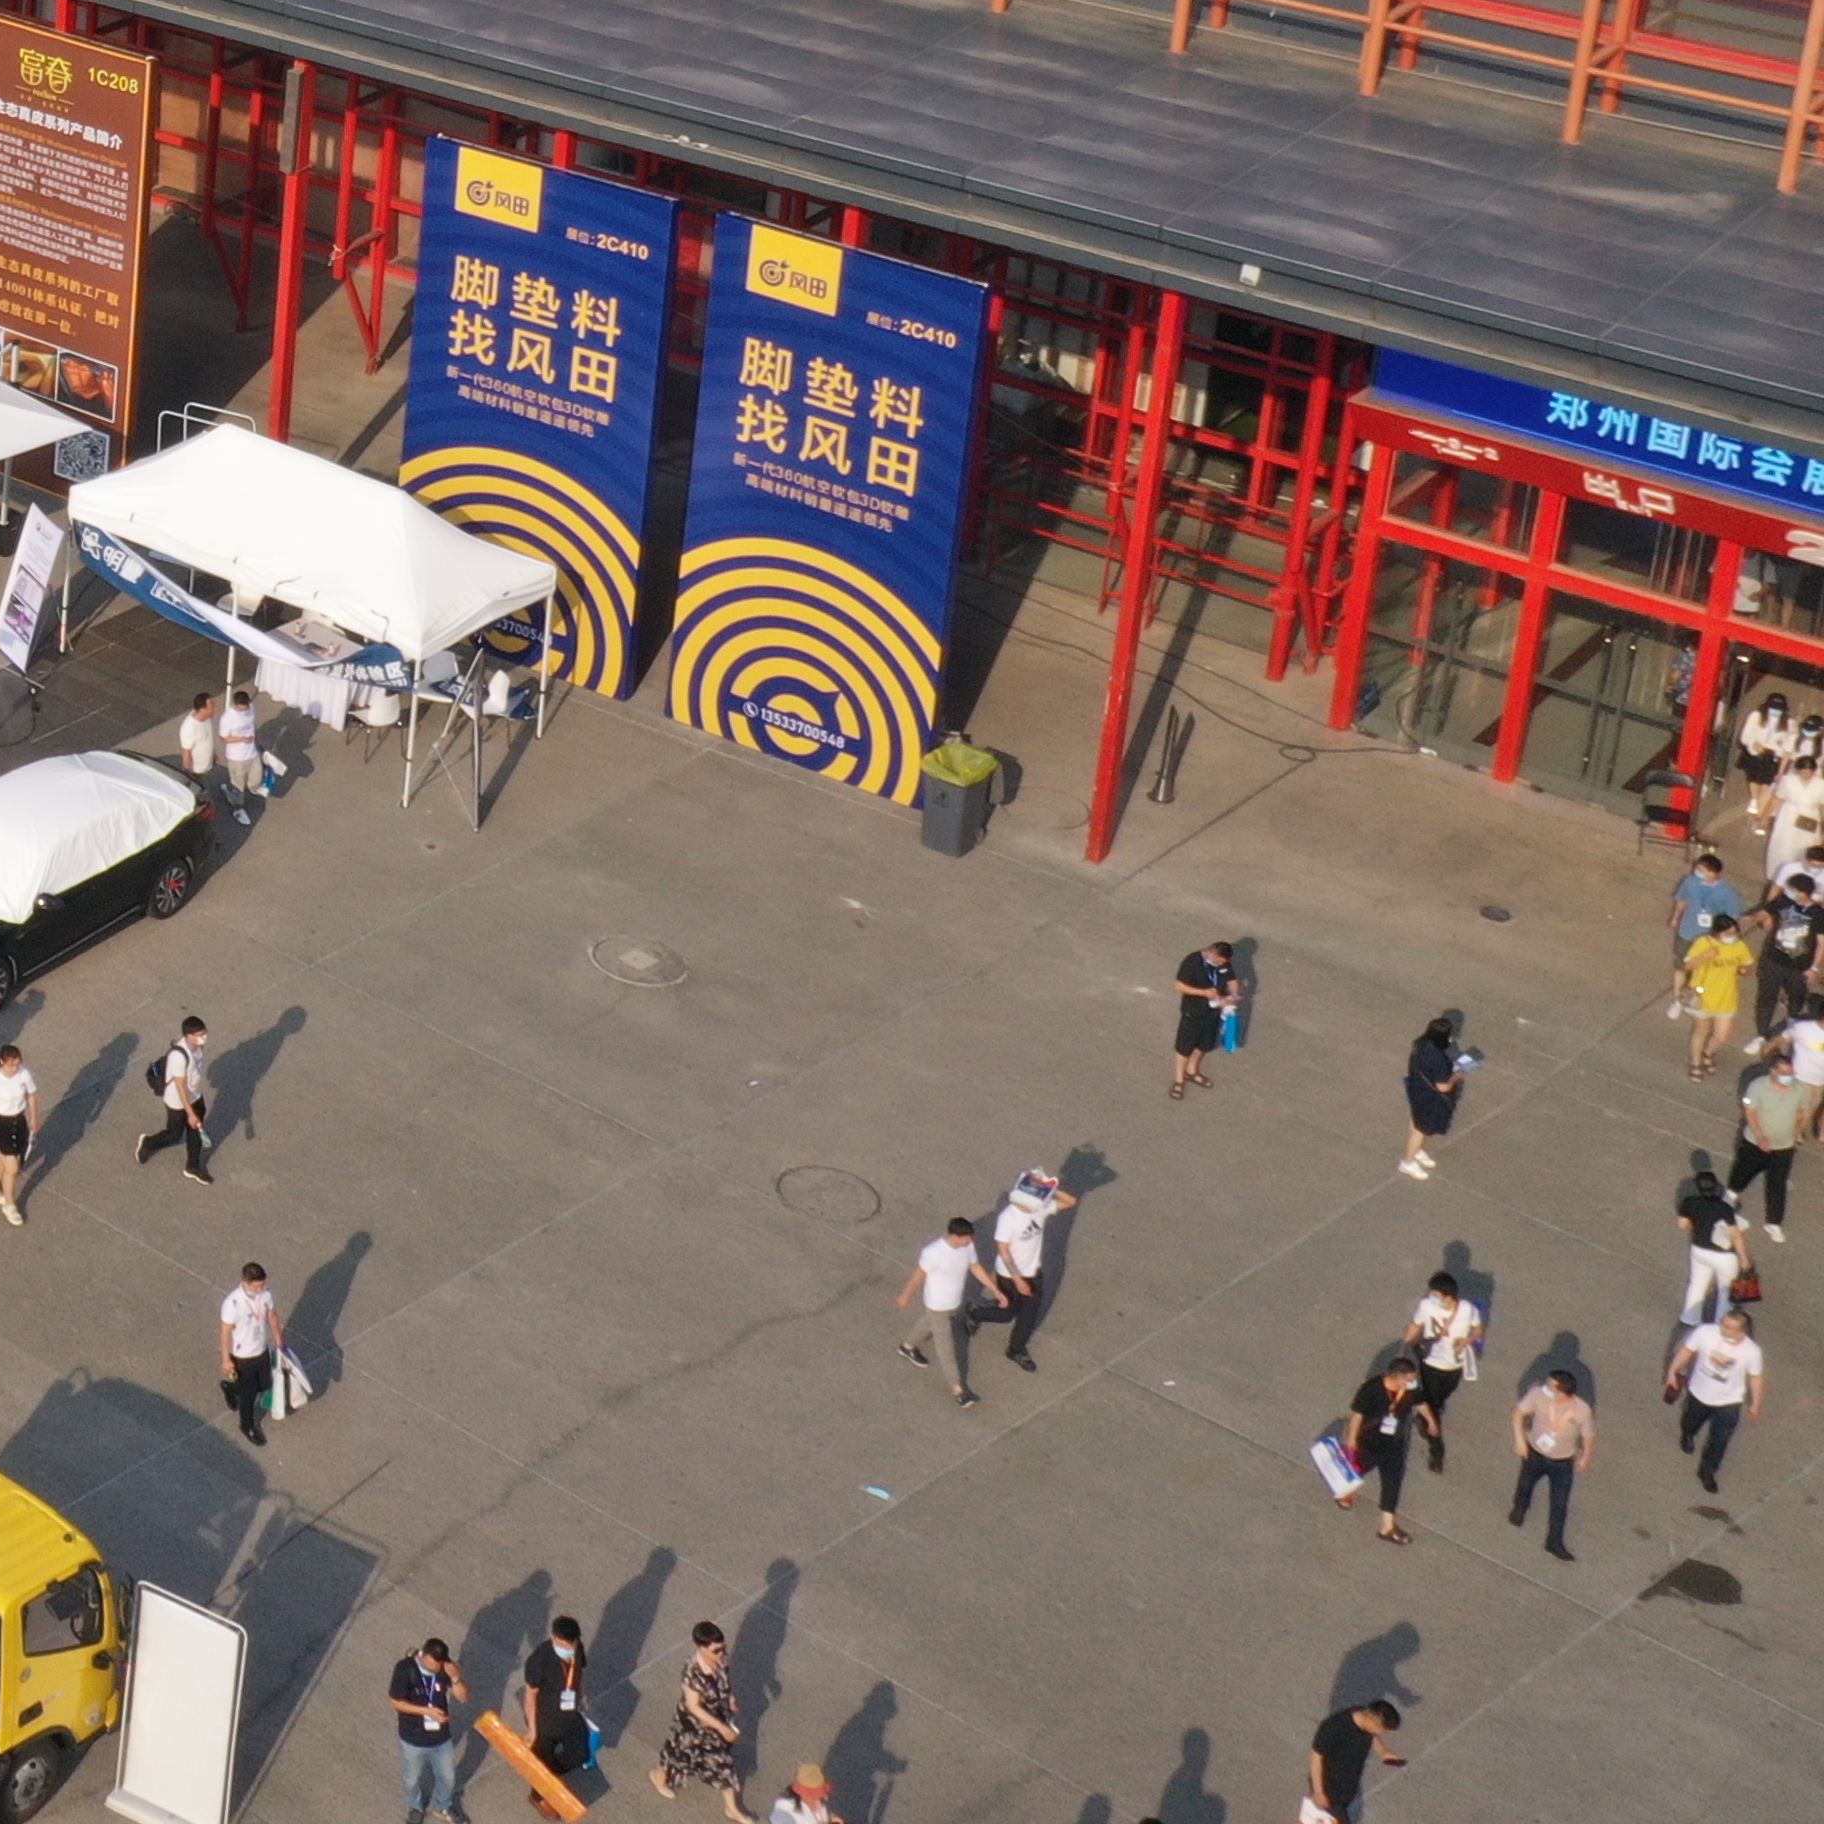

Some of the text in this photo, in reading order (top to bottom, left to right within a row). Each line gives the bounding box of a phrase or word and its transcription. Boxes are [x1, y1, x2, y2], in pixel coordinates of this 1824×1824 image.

[88, 66, 139, 95] 1C208
[494, 190, 531, 218] 风田
[596, 232, 650, 262] 2C410
[450, 254, 622, 348] 脚垫料
[788, 269, 828, 300] 风田
[899, 316, 957, 350] 2C410
[447, 309, 618, 404] 找风田
[739, 336, 924, 440] 脚垫料
[735, 392, 920, 498] 找风田
[759, 706, 846, 751] 13533700548
